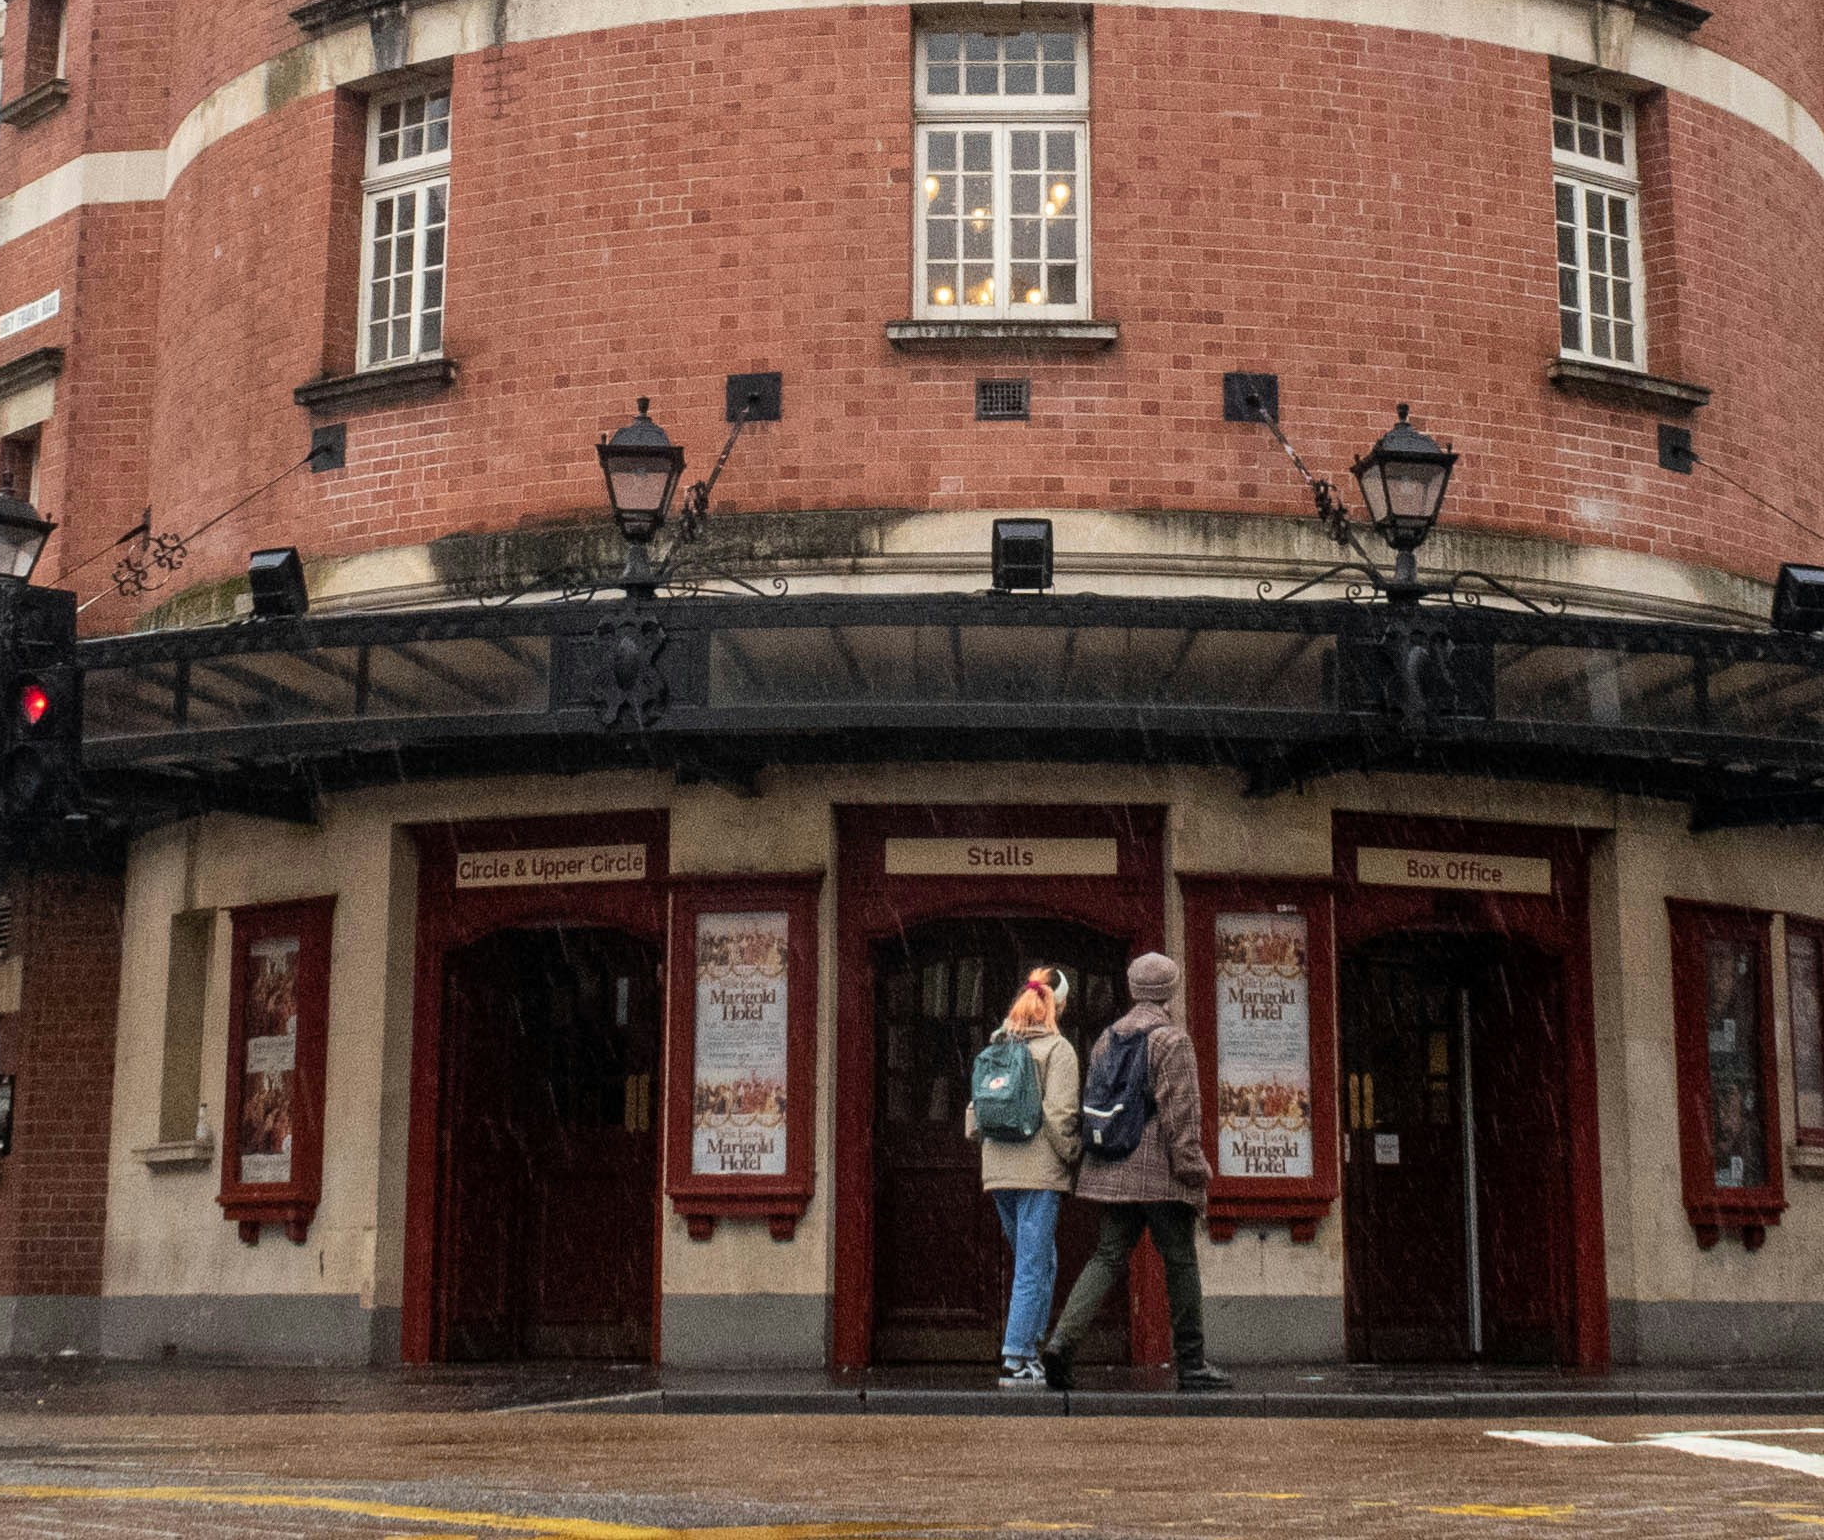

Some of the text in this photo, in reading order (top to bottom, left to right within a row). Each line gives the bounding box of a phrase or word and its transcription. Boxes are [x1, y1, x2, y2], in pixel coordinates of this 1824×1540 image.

[967, 846, 1034, 866] Stalls
[459, 852, 643, 880] Circle & Upper Circle
[1407, 860, 1503, 882] Box Office
[710, 989, 776, 1008] Marigold
[1228, 988, 1295, 1007] Marigold
[721, 1004, 763, 1021] Hotel
[1241, 1004, 1282, 1020] Hotel
[707, 1139, 774, 1158] Marigold
[1231, 1141, 1298, 1160] Marigold
[720, 1156, 761, 1171] Hotel
[1245, 1158, 1286, 1173] Hotel
